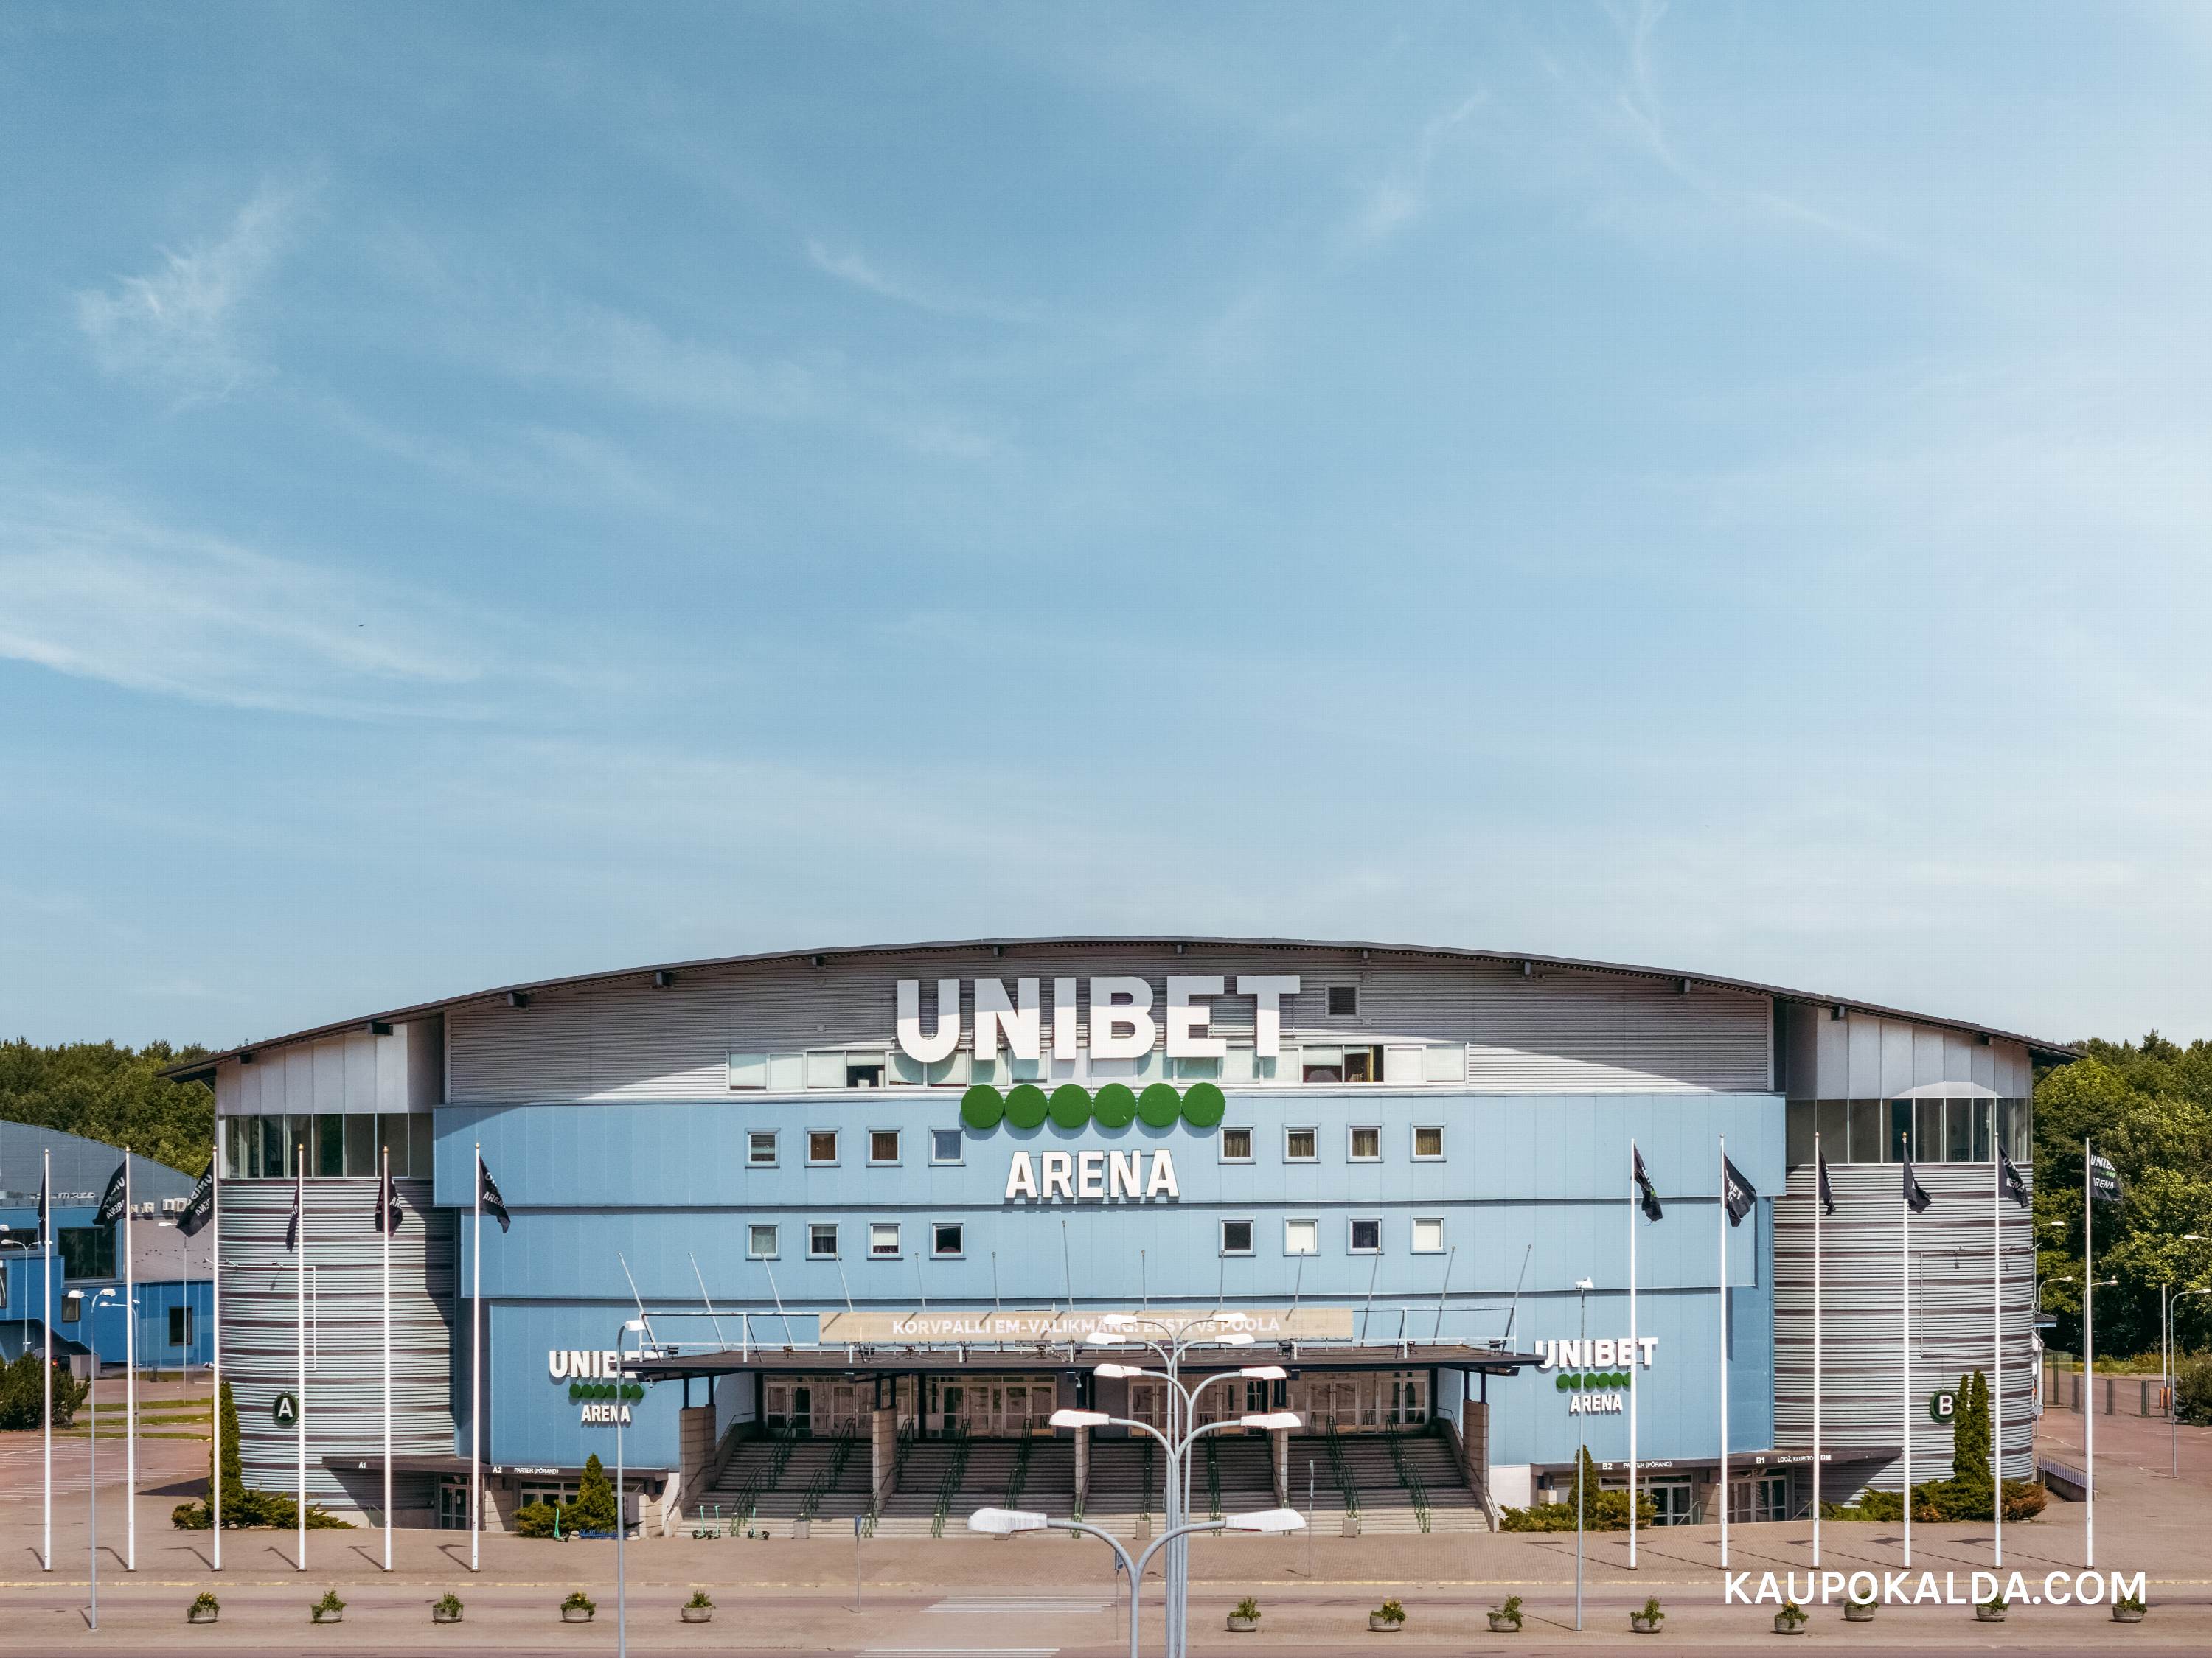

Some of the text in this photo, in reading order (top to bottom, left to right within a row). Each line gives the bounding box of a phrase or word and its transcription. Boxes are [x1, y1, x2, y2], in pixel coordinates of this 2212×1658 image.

[897, 975, 1301, 1062] UNIBET
[1004, 1149, 1180, 1198] ARENA
[893, 1320, 990, 1334] KORVPALLI
[1144, 1318, 1192, 1333] EESTI
[1220, 1317, 1280, 1332] POOLA
[1534, 1337, 1658, 1369] UNIBET
[278, 1398, 293, 1418] A
[1569, 1393, 1624, 1413] ARENA
[1939, 1395, 1953, 1415] B
[581, 1405, 630, 1422] ARENA
[1756, 1456, 1766, 1464] B1
